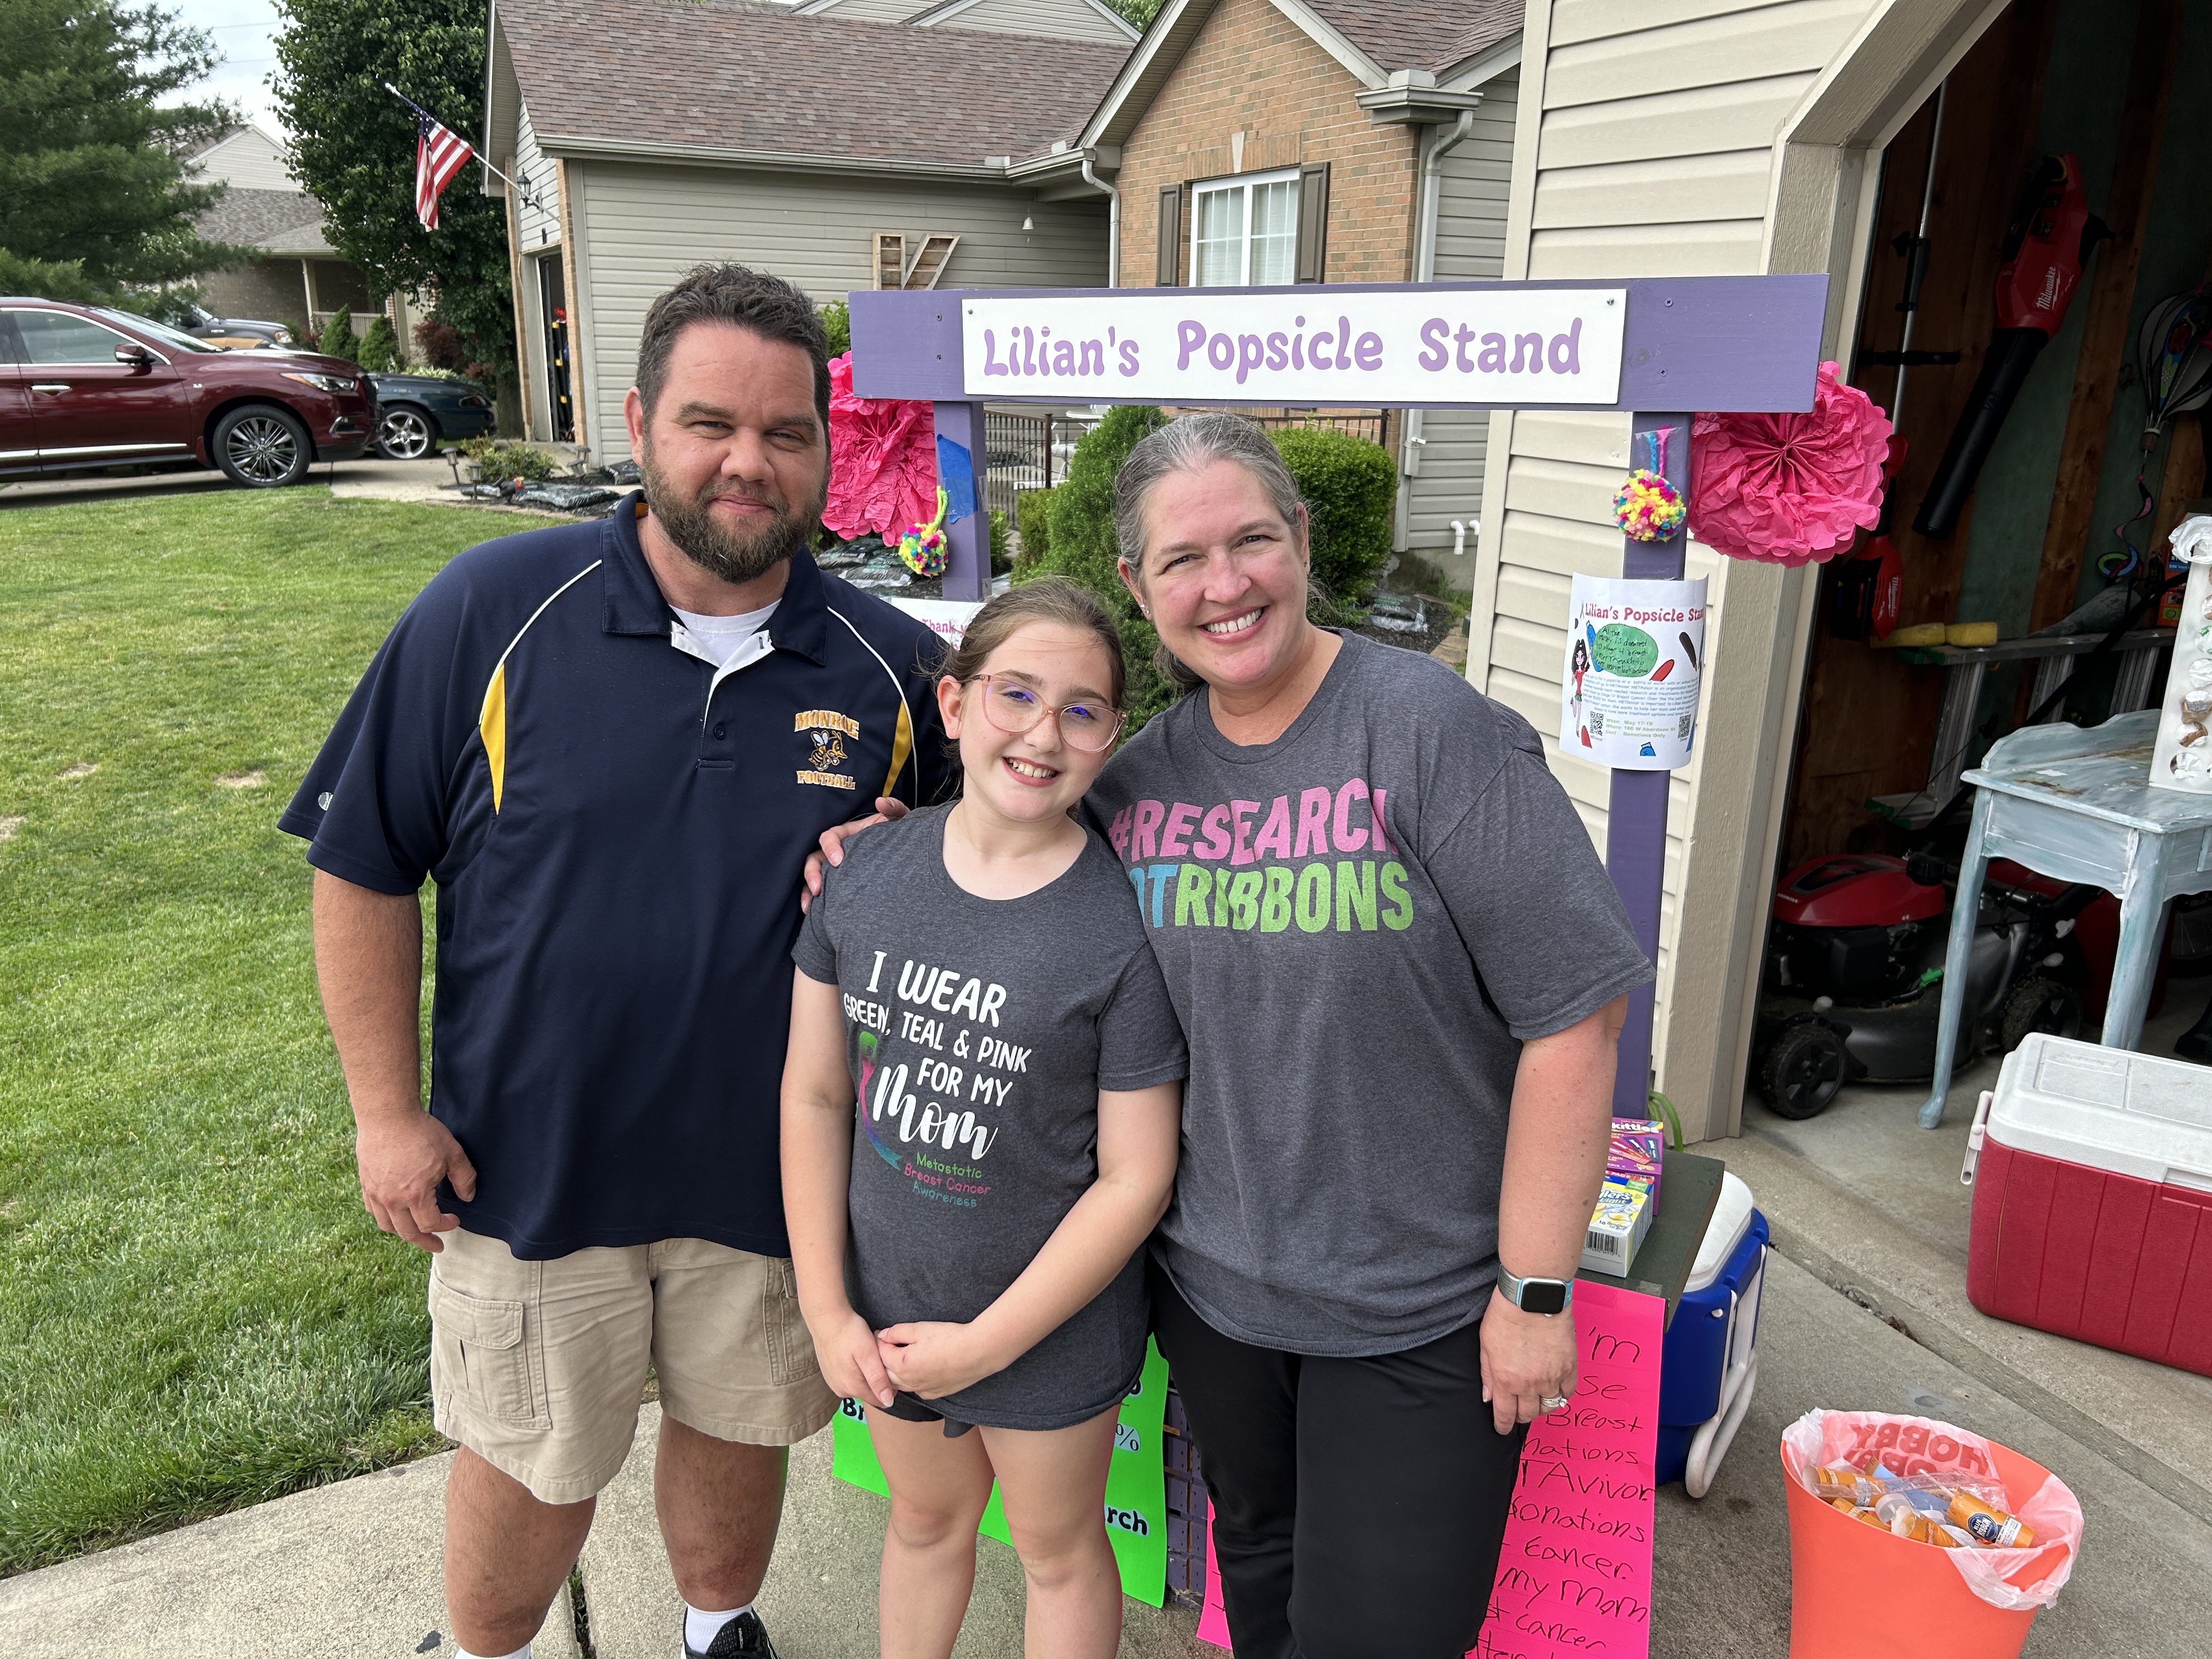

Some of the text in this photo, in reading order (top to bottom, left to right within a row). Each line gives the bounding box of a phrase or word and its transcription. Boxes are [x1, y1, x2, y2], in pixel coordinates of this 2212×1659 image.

[2035, 266, 2056, 310] Milwaukee
[984, 315, 1583, 384] Lilian's Popsicle Stand
[1585, 602, 1618, 620] Lilian's
[1624, 607, 1684, 625] Popsicle
[794, 709, 860, 741] MONROE
[796, 770, 856, 790] FOOTBALL
[866, 951, 1007, 1028] I WEAR
[843, 992, 1032, 1073] GREEN, TEAL & PINK
[916, 1057, 1013, 1107] FOR MY
[904, 1162, 992, 1195] Breast Cancer
[916, 1152, 983, 1180] Metastatic
[912, 1180, 977, 1207] Awareness
[1545, 1403, 1643, 1432] Breast
[1497, 1567, 1549, 1609] my
